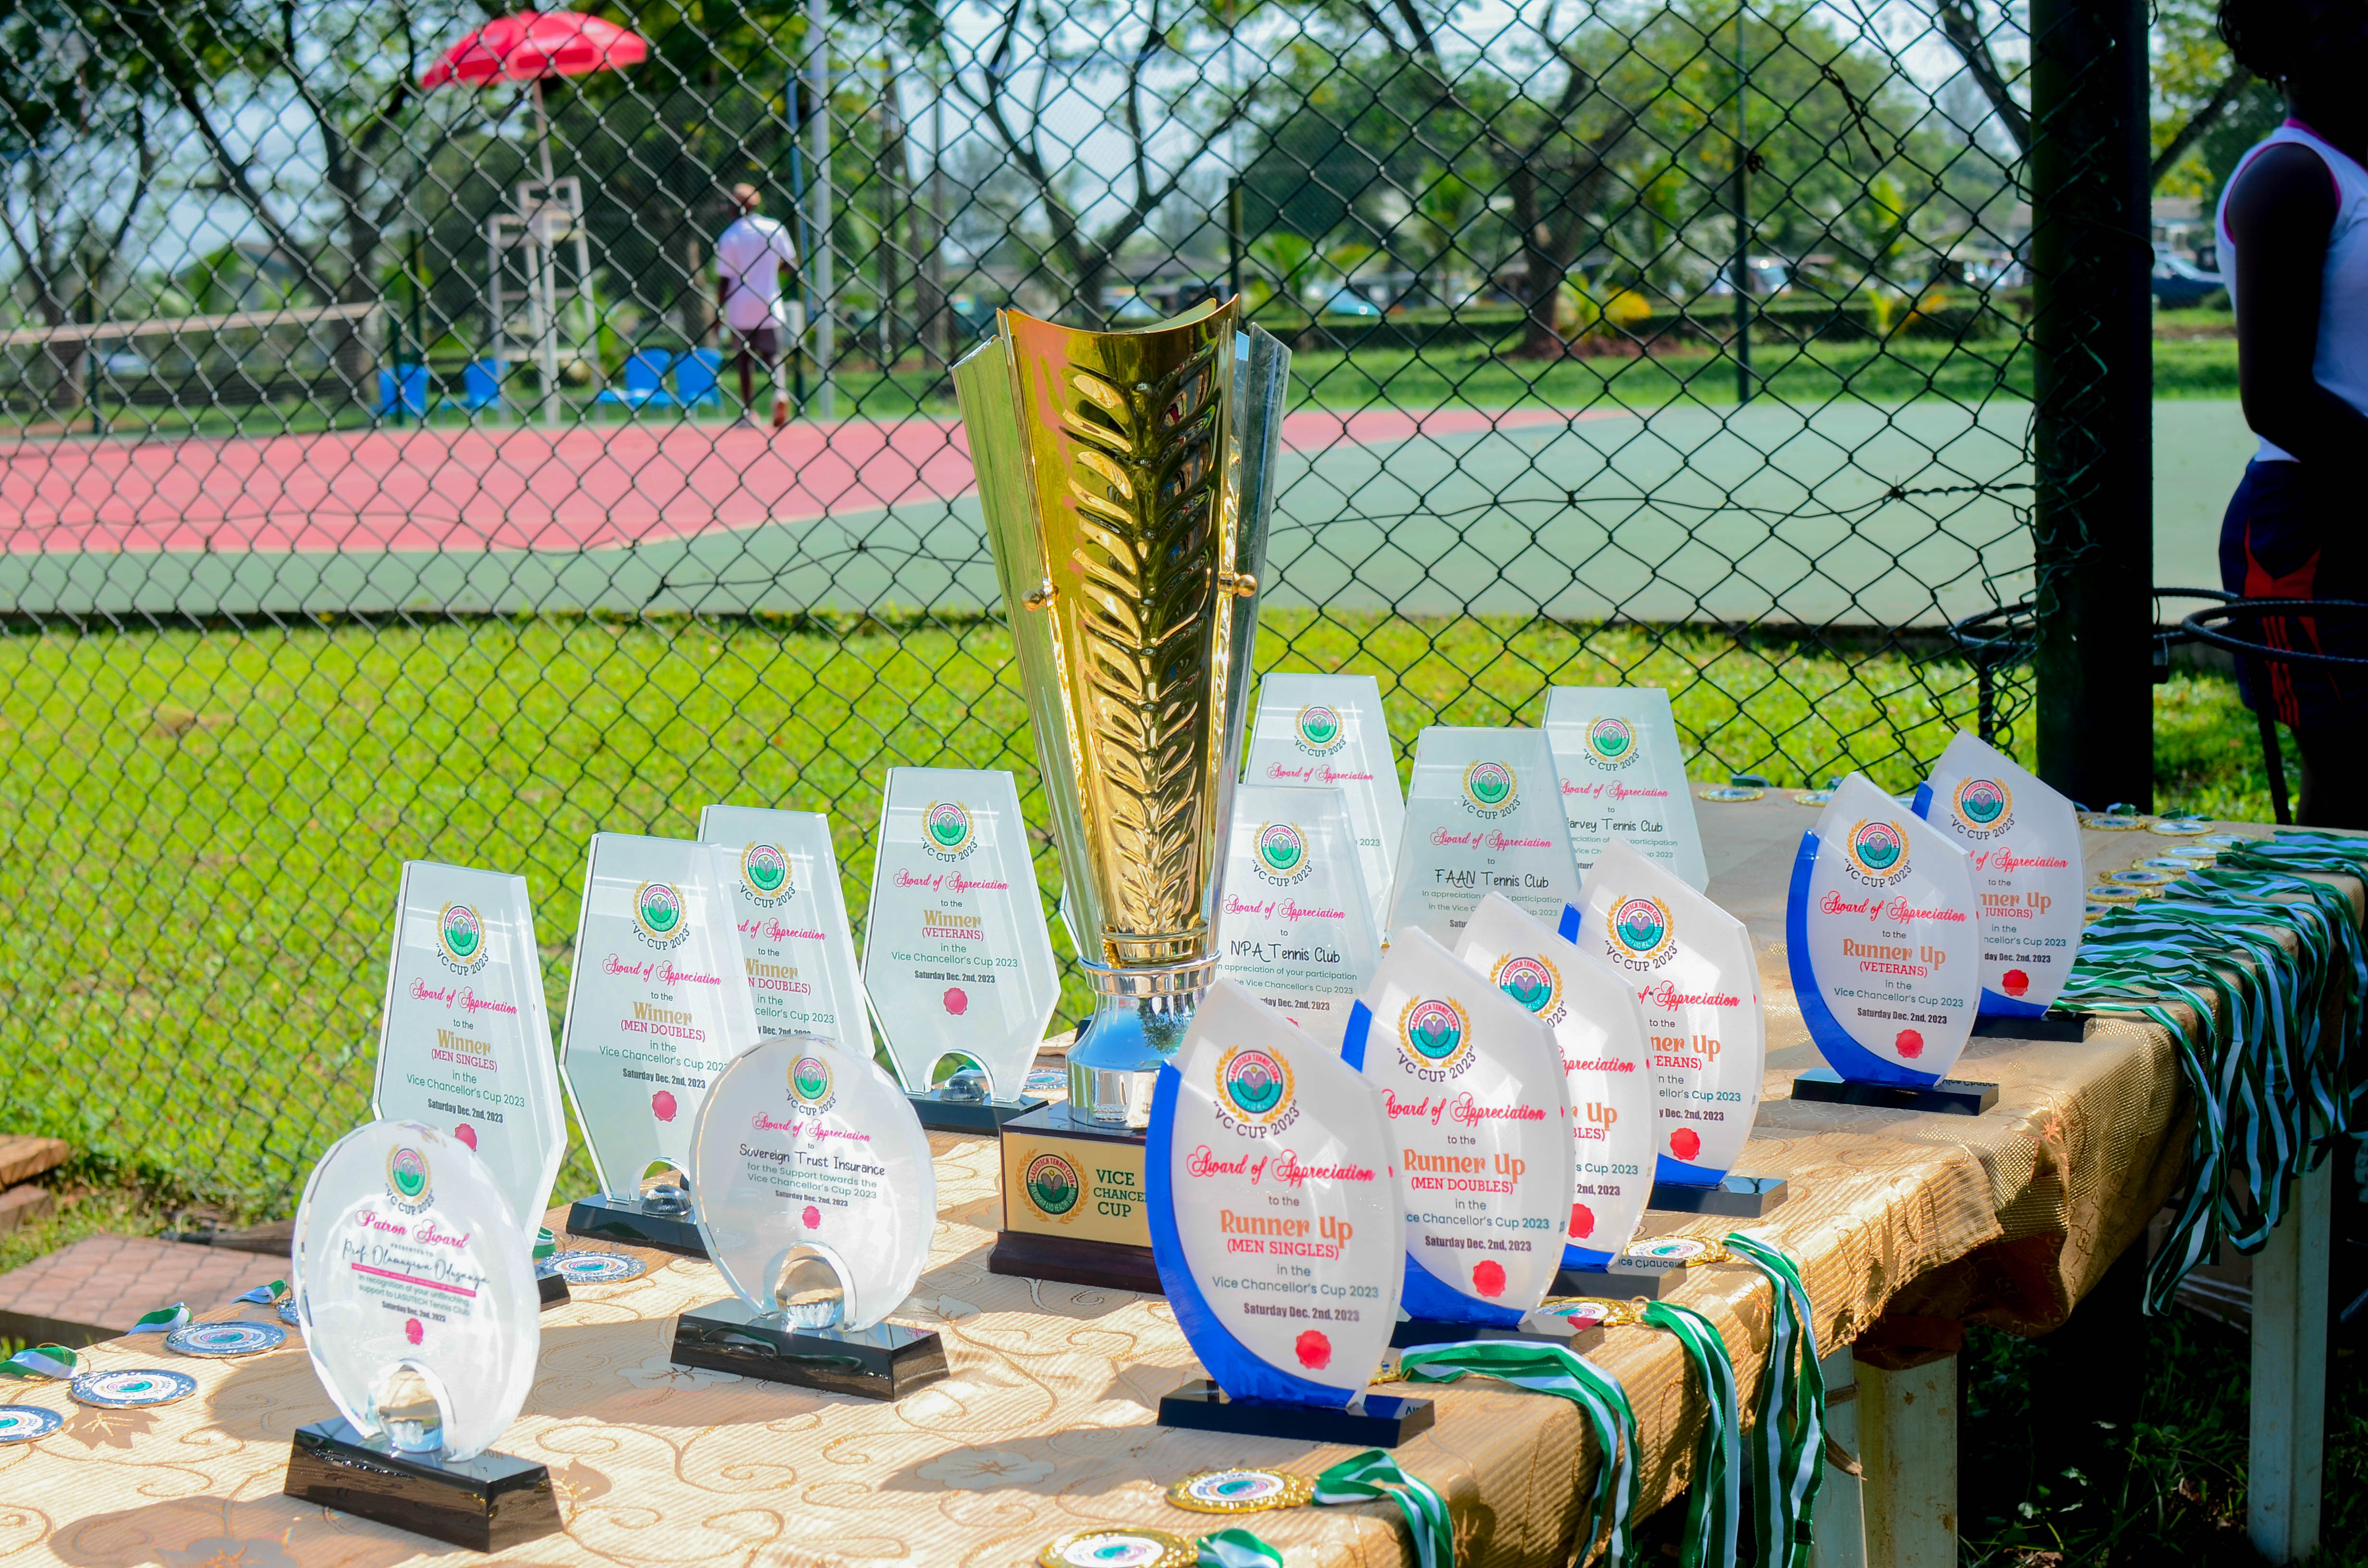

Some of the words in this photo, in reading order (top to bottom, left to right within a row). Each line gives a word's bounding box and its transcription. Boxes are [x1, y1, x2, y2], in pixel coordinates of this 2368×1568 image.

[1267, 762, 1302, 779] Award
[1304, 768, 1314, 782] of
[1317, 764, 1374, 783] Appreciation
[1560, 778, 1592, 795] Award
[1593, 784, 1604, 799] of
[1607, 780, 1668, 800] Appreciation
[1602, 818, 1636, 831] Tennis
[1641, 820, 1663, 832] Club
[1431, 827, 1471, 846] Award
[1472, 833, 1483, 850] of
[1485, 829, 1552, 851] Appreciation
[936, 852, 956, 862] CUP
[1976, 851, 1989, 871] of
[1991, 846, 2068, 872] Appreciation
[893, 868, 931, 888] Award
[933, 875, 943, 892] of
[946, 870, 1009, 893] Appreciation
[1435, 869, 1475, 888] FAAN
[1481, 871, 1519, 887] Tennis
[1525, 873, 1549, 888] Club
[1862, 876, 1885, 888] CUP
[1223, 894, 1263, 914] Award
[1265, 901, 1276, 919] of
[1278, 898, 1345, 921] Appreciation
[1512, 895, 1562, 904] participation
[1820, 890, 1869, 914] Award
[1870, 900, 1884, 921] of
[1887, 896, 1967, 924] Appreciation
[2027, 892, 2051, 915] Up
[751, 921, 761, 939] of
[763, 918, 826, 942] Appreciation
[924, 910, 981, 928] Winner
[923, 928, 984, 942] (VETERANS)
[2023, 938, 2042, 948] Cup
[892, 952, 911, 961] Vice
[914, 953, 971, 965] Chancellor's
[974, 957, 993, 968] Cup
[996, 958, 1018, 967] 2023
[1231, 941, 1271, 963] NPA
[1268, 943, 1309, 961] Tennis
[1315, 947, 1340, 963] Club
[1843, 939, 1912, 961] Runner
[1920, 946, 1946, 971] Up
[602, 953, 641, 975] Award
[643, 964, 654, 982] of
[656, 960, 721, 986] Appreciation
[915, 970, 945, 981] Saturday
[947, 972, 961, 981] Dec.
[962, 973, 976, 983] 2nd,
[978, 974, 995, 983] 2023
[1224, 965, 1274, 974] appreciation
[1277, 967, 1284, 975] of
[1306, 970, 1357, 980] participation
[1860, 961, 1927, 978] (VETERANS)
[410, 978, 445, 1000] Award
[446, 990, 456, 1009] of
[458, 986, 517, 1014] Appreciation
[758, 979, 811, 995] DOUBLES)
[1265, 981, 1313, 992] Chancellor's
[1316, 985, 1332, 994] Cup
[1651, 980, 1740, 1012] Appreciation
[1834, 988, 1854, 996] Vice
[1857, 990, 1915, 1003] Chancellor's
[1918, 995, 1938, 1007] Cup
[1941, 998, 1963, 1007] 2023
[633, 1001, 692, 1025] Winner
[790, 1011, 809, 1023] Cup
[812, 1013, 834, 1023] 2023
[1858, 1008, 1891, 1019] Saturday
[1893, 1011, 1909, 1020] Dec.
[1911, 1013, 1926, 1022] 2nd,
[1928, 1015, 1947, 1024] 2023
[437, 1029, 491, 1055] Winner
[621, 1019, 647, 1033] (MEN
[651, 1023, 705, 1042] DOUBLES)
[432, 1049, 454, 1062] (MEN
[456, 1054, 497, 1072] SINGLES)
[1693, 1035, 1720, 1063] Up
[623, 1068, 654, 1081] Saturday
[655, 1073, 670, 1084] Dec.
[672, 1075, 686, 1087] 2nd,
[688, 1078, 705, 1089] 2023
[407, 1074, 425, 1086] Vice
[427, 1078, 481, 1098] Chancellor's
[483, 1090, 501, 1105] Cup
[504, 1094, 524, 1107] 2023
[428, 1099, 456, 1114] Saturday
[457, 1104, 471, 1116] Dec.
[472, 1108, 485, 1120] 2nd,
[487, 1110, 503, 1123] 2023
[1431, 1098, 1446, 1125] of
[1450, 1091, 1546, 1127] Appreciation
[1586, 1102, 1617, 1131] Up
[752, 1112, 791, 1130] Award
[793, 1122, 803, 1138] of
[807, 1119, 871, 1141] Appreciation
[740, 1143, 789, 1165] Sovereign
[795, 1152, 828, 1167] Trust
[834, 1156, 885, 1176] Insurance
[1050, 1158, 1067, 1171] TENNIS
[1066, 1170, 1075, 1183] CLUB
[1187, 1145, 1249, 1177] Award
[1251, 1156, 1268, 1185] of
[1271, 1149, 1376, 1188] Appreciation
[1403, 1149, 1485, 1173] Runner
[1494, 1153, 1525, 1185] Up
[748, 1173, 767, 1182] Vice
[771, 1176, 830, 1192] Chancellor's
[831, 1186, 851, 1197] Cup
[854, 1188, 876, 1199] 2023
[780, 1167, 817, 1178] Support
[820, 1173, 858, 1186] towards
[862, 1179, 876, 1188] the
[1096, 1169, 1134, 1186] VICE
[1411, 1177, 1443, 1190] (MEN
[1447, 1178, 1514, 1195] DOUBLES)
[1098, 1201, 1131, 1217] CUP
[358, 1209, 407, 1236] Patron
[412, 1219, 469, 1248] Award
[1221, 1210, 1310, 1237] Runner
[1320, 1216, 1353, 1250] Up
[1227, 1238, 1265, 1254] (MEN
[1270, 1241, 1339, 1261] SINGLES)
[1212, 1276, 1238, 1288] Vice
[1241, 1279, 1317, 1294] Chancellor's
[1320, 1285, 1346, 1298] Cup
[1350, 1286, 1379, 1298] 2023
